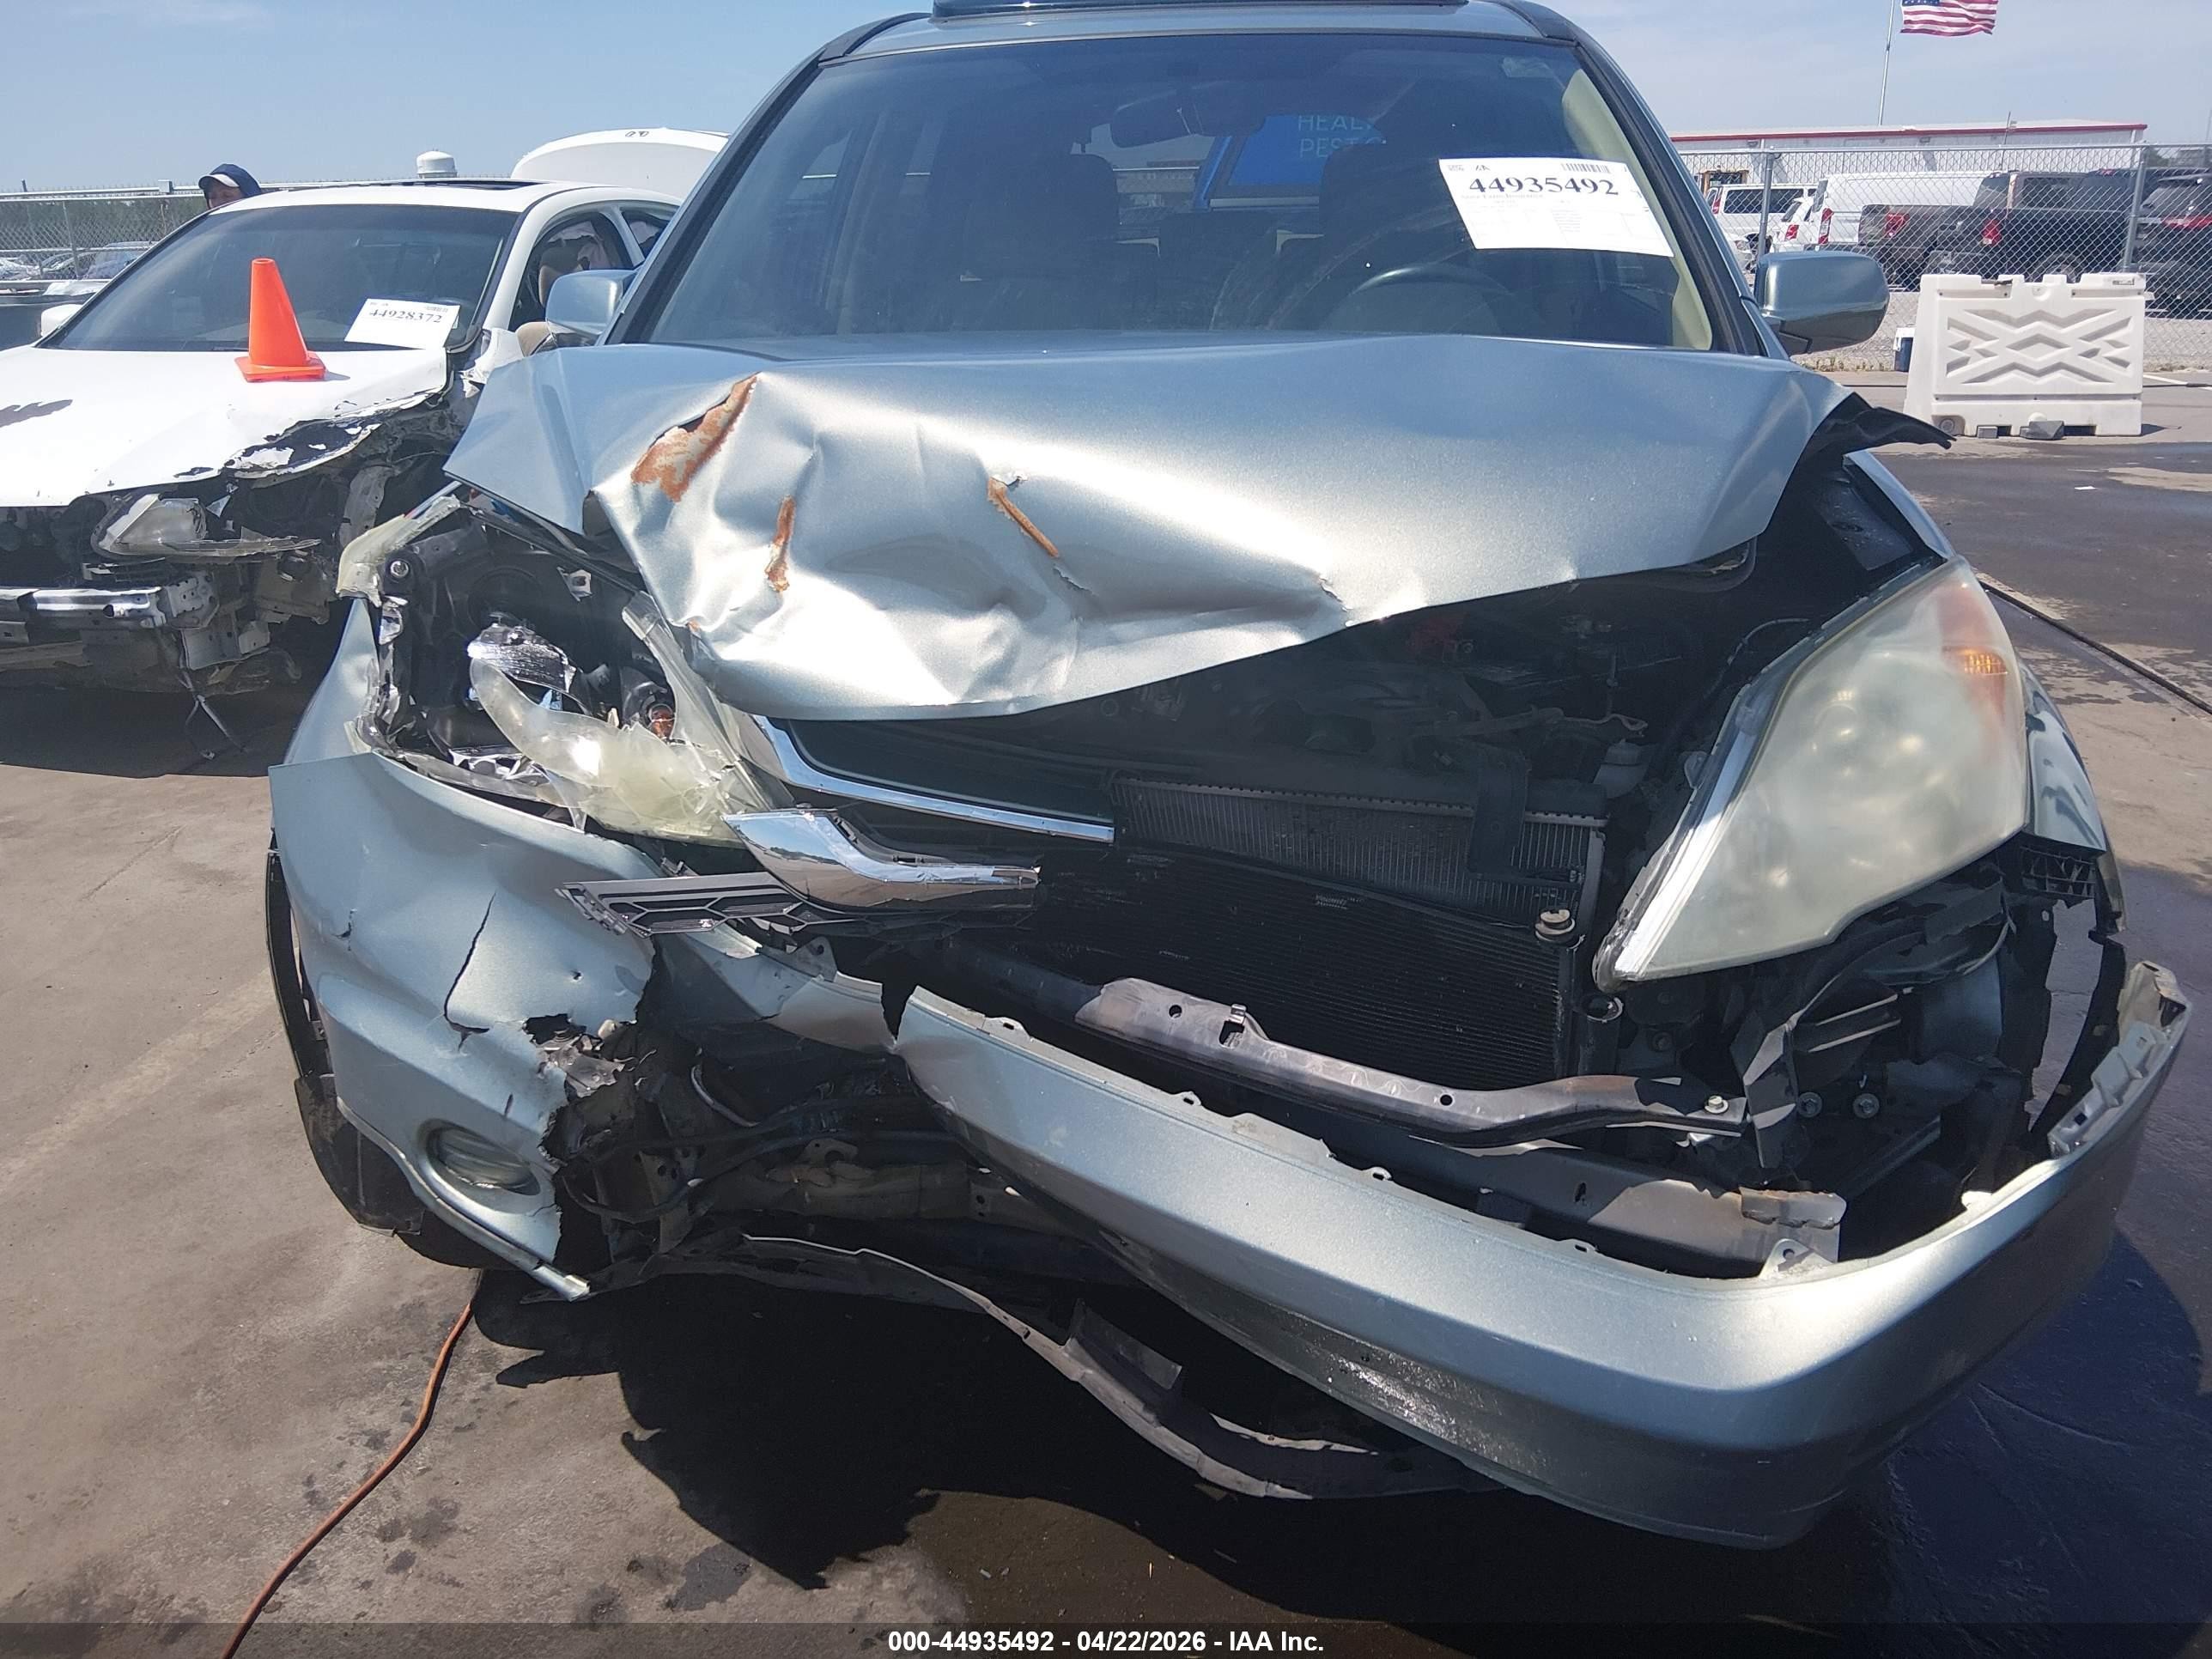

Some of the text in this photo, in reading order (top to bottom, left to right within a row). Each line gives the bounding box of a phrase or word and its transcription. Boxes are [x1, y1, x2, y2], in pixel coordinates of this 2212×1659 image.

[1298, 115, 1372, 131] HEAL
[1469, 177, 1619, 195] 44935492
[369, 309, 442, 323] 44928372
